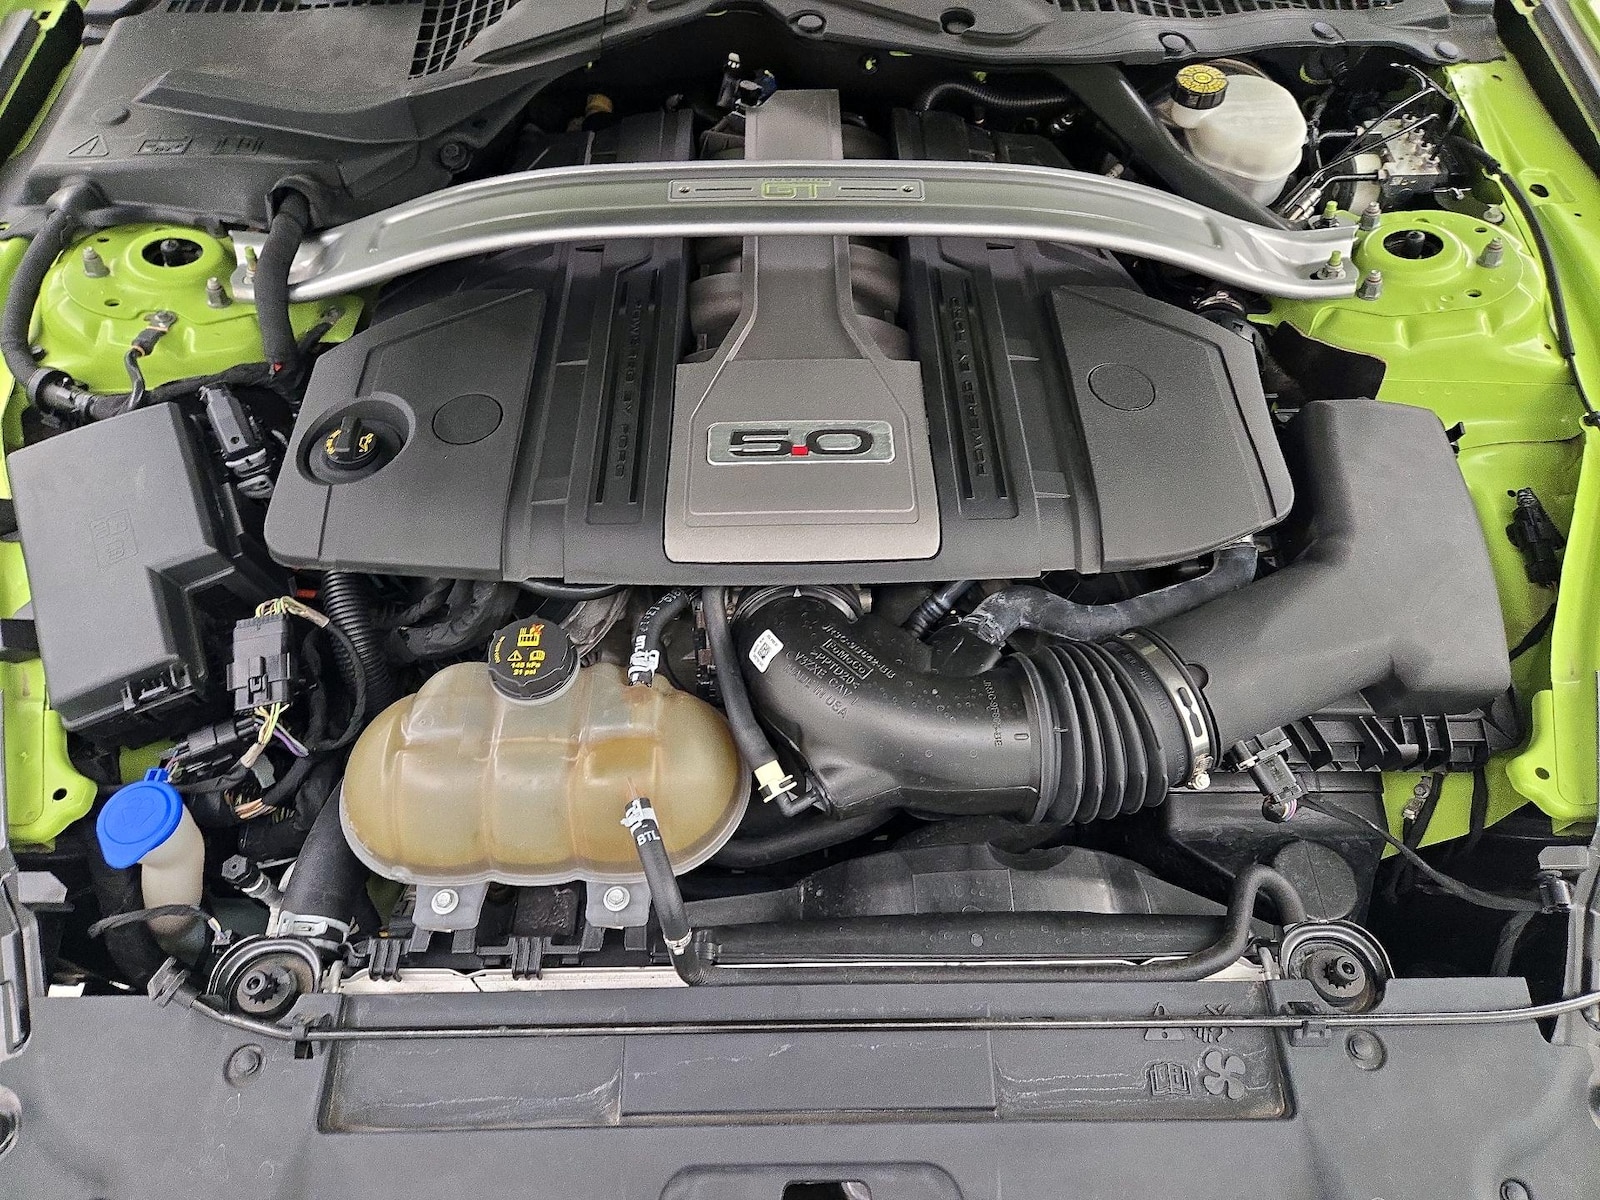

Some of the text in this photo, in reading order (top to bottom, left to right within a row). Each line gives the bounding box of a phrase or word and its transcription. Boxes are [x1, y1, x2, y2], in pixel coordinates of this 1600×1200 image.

[761, 181, 831, 198] GT
[727, 428, 874, 457] 5.0
[825, 640, 866, 675] FoMoCo
[524, 668, 537, 677] psi
[784, 663, 848, 719] MADE IN USA
[637, 830, 661, 847] BTL
